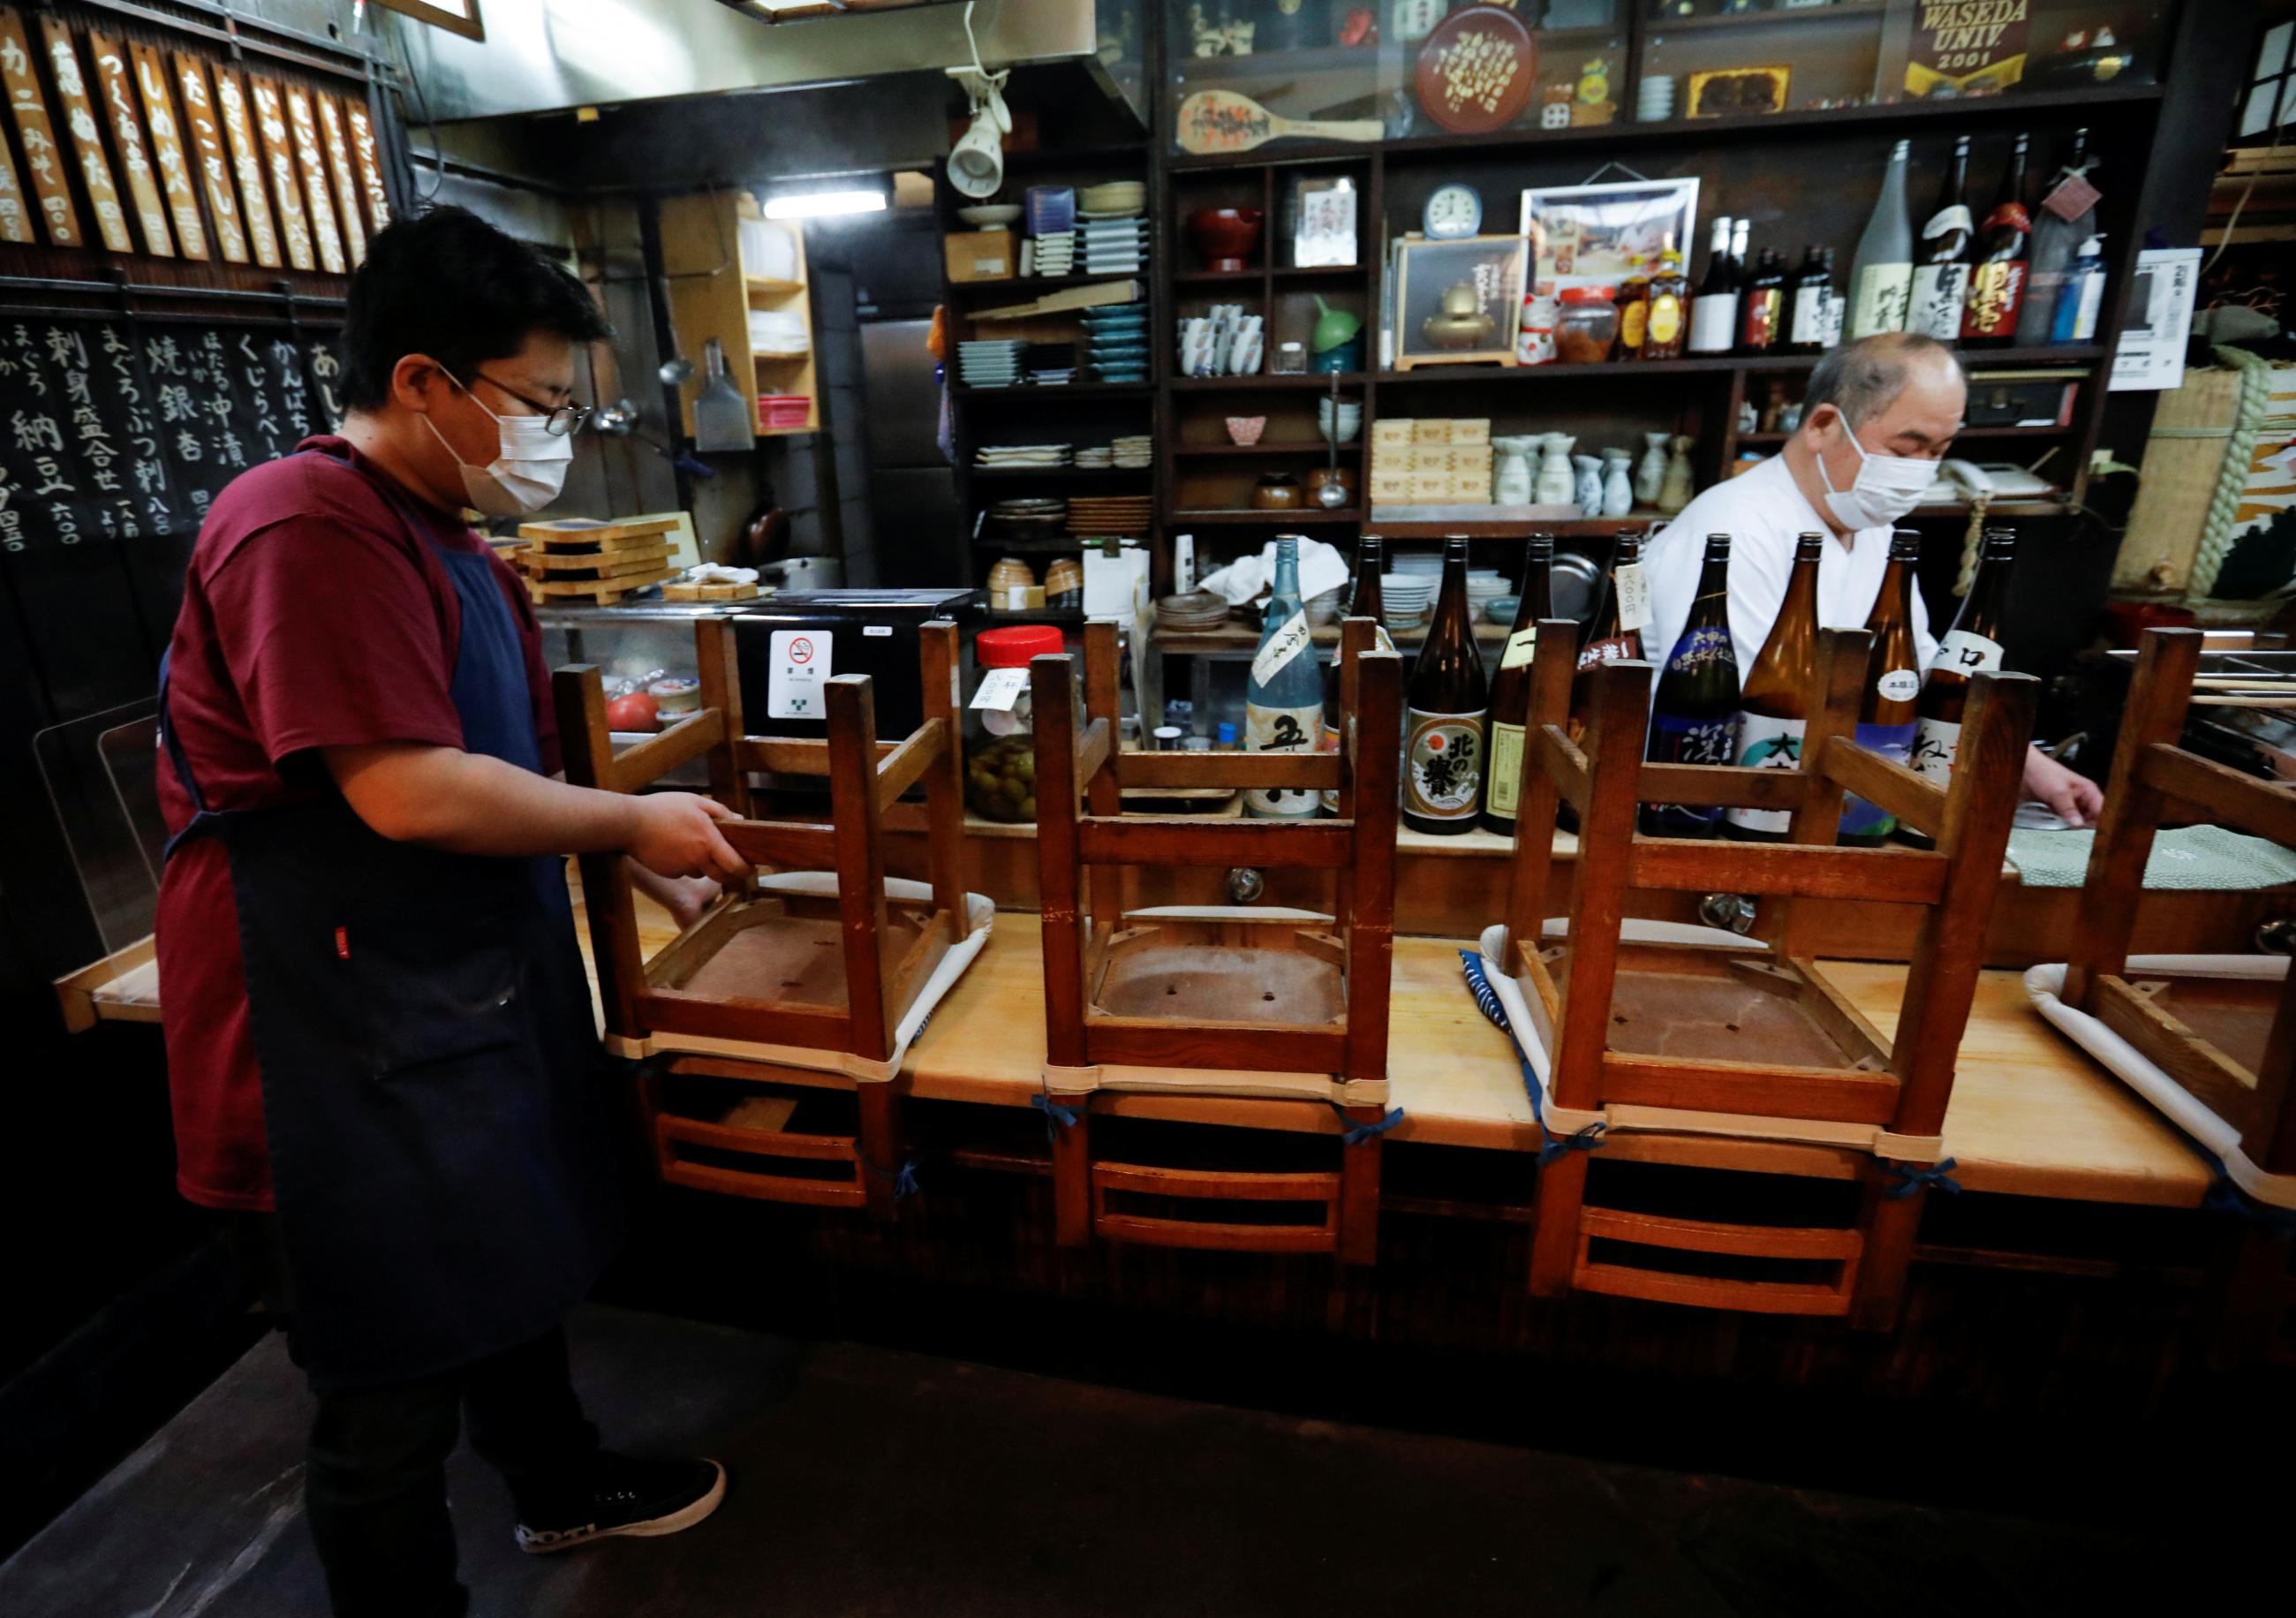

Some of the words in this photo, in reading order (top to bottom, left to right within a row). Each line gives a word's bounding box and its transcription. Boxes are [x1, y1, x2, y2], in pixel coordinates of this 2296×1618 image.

[1922, 1, 2028, 31] WASEDA
[1933, 24, 2002, 52] UNIV.
[1937, 52, 1990, 70] 2001
[14, 324, 47, 397] まぐろ
[45, 327, 123, 491] 刺身盛合せ
[146, 335, 202, 462] 焼銀杏
[11, 410, 76, 495] 納豆
[50, 502, 81, 544] 六〇〇
[147, 496, 171, 535] 八〇〇
